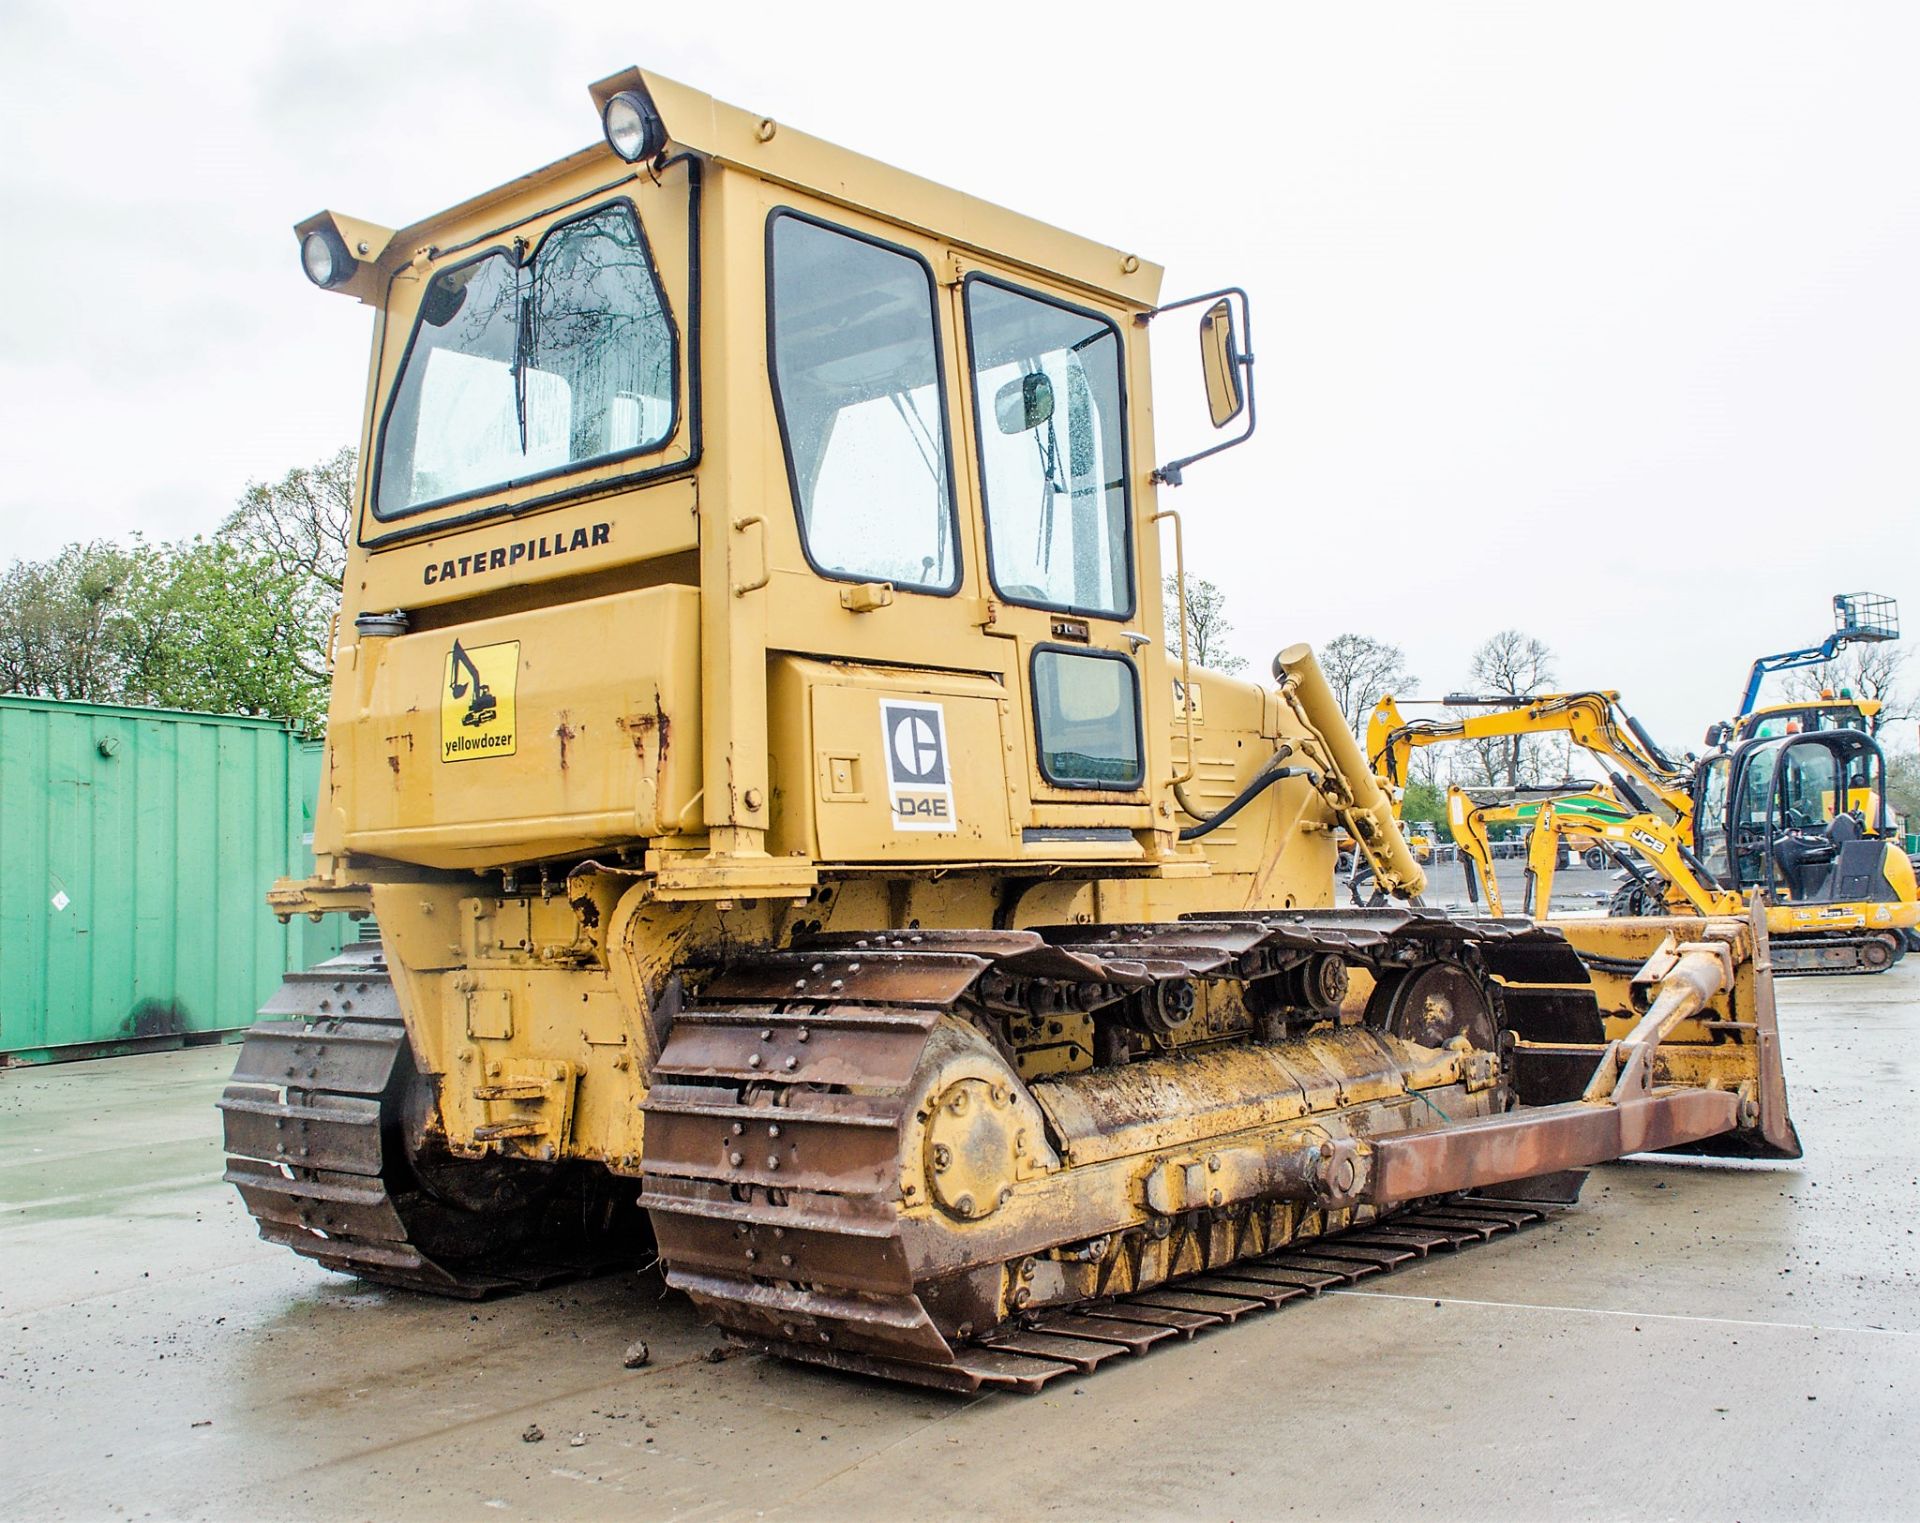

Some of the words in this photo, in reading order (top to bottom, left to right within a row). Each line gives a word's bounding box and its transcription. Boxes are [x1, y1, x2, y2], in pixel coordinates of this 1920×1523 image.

[423, 522, 610, 586] CATERPILLAR
[445, 733, 513, 756] yellowdozer
[898, 798, 947, 817] D4E
[1631, 828, 1668, 854] JCB
